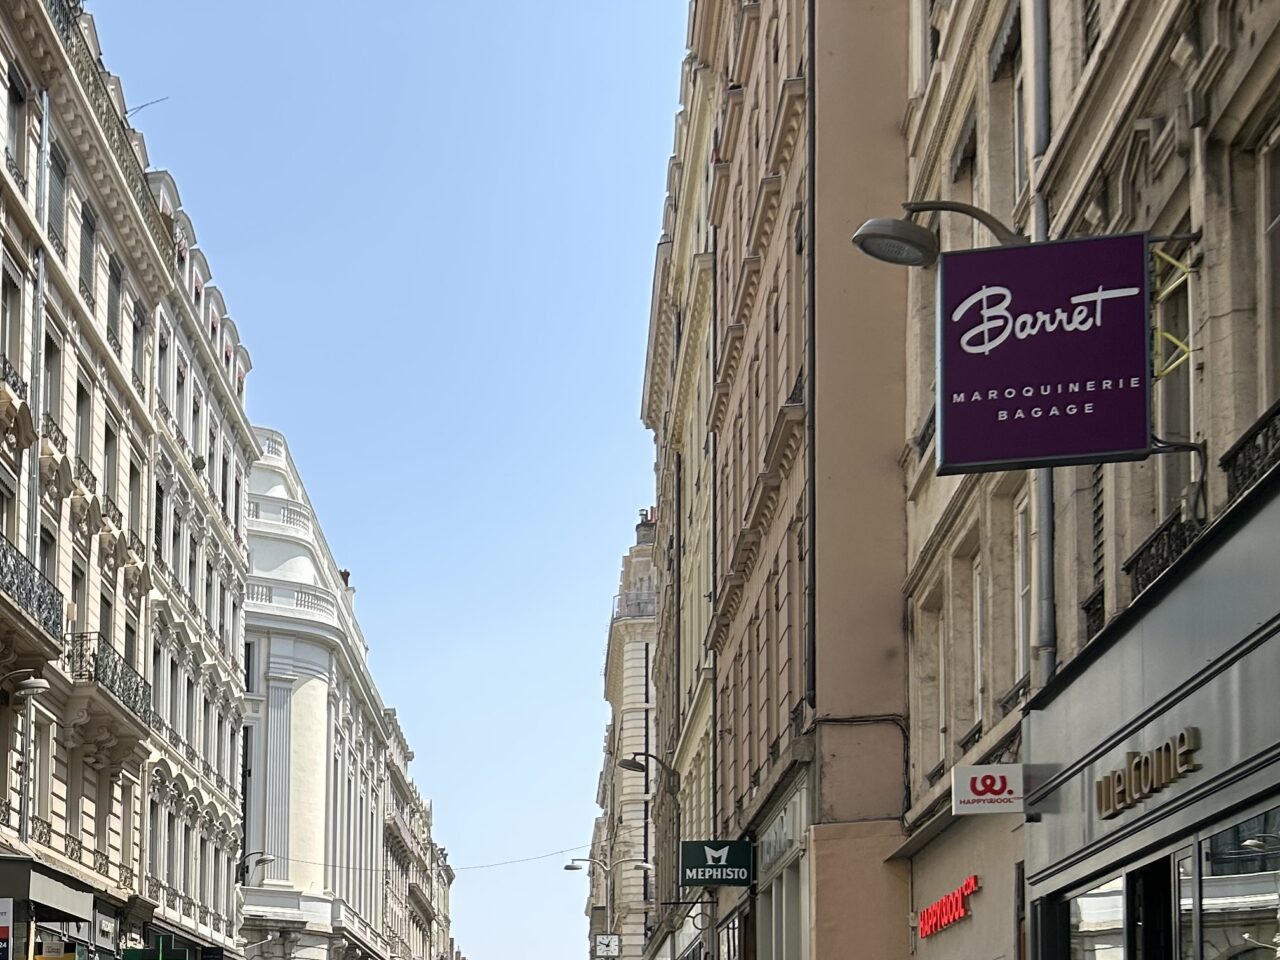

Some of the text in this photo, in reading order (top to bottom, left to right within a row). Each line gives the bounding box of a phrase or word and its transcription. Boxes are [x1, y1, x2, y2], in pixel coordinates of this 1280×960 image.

[951, 285, 1140, 356] Barret
[952, 377, 1141, 403] MAROQUINERIE
[997, 403, 1095, 421] BAGAGE
[685, 868, 748, 880] MEPHISTO
